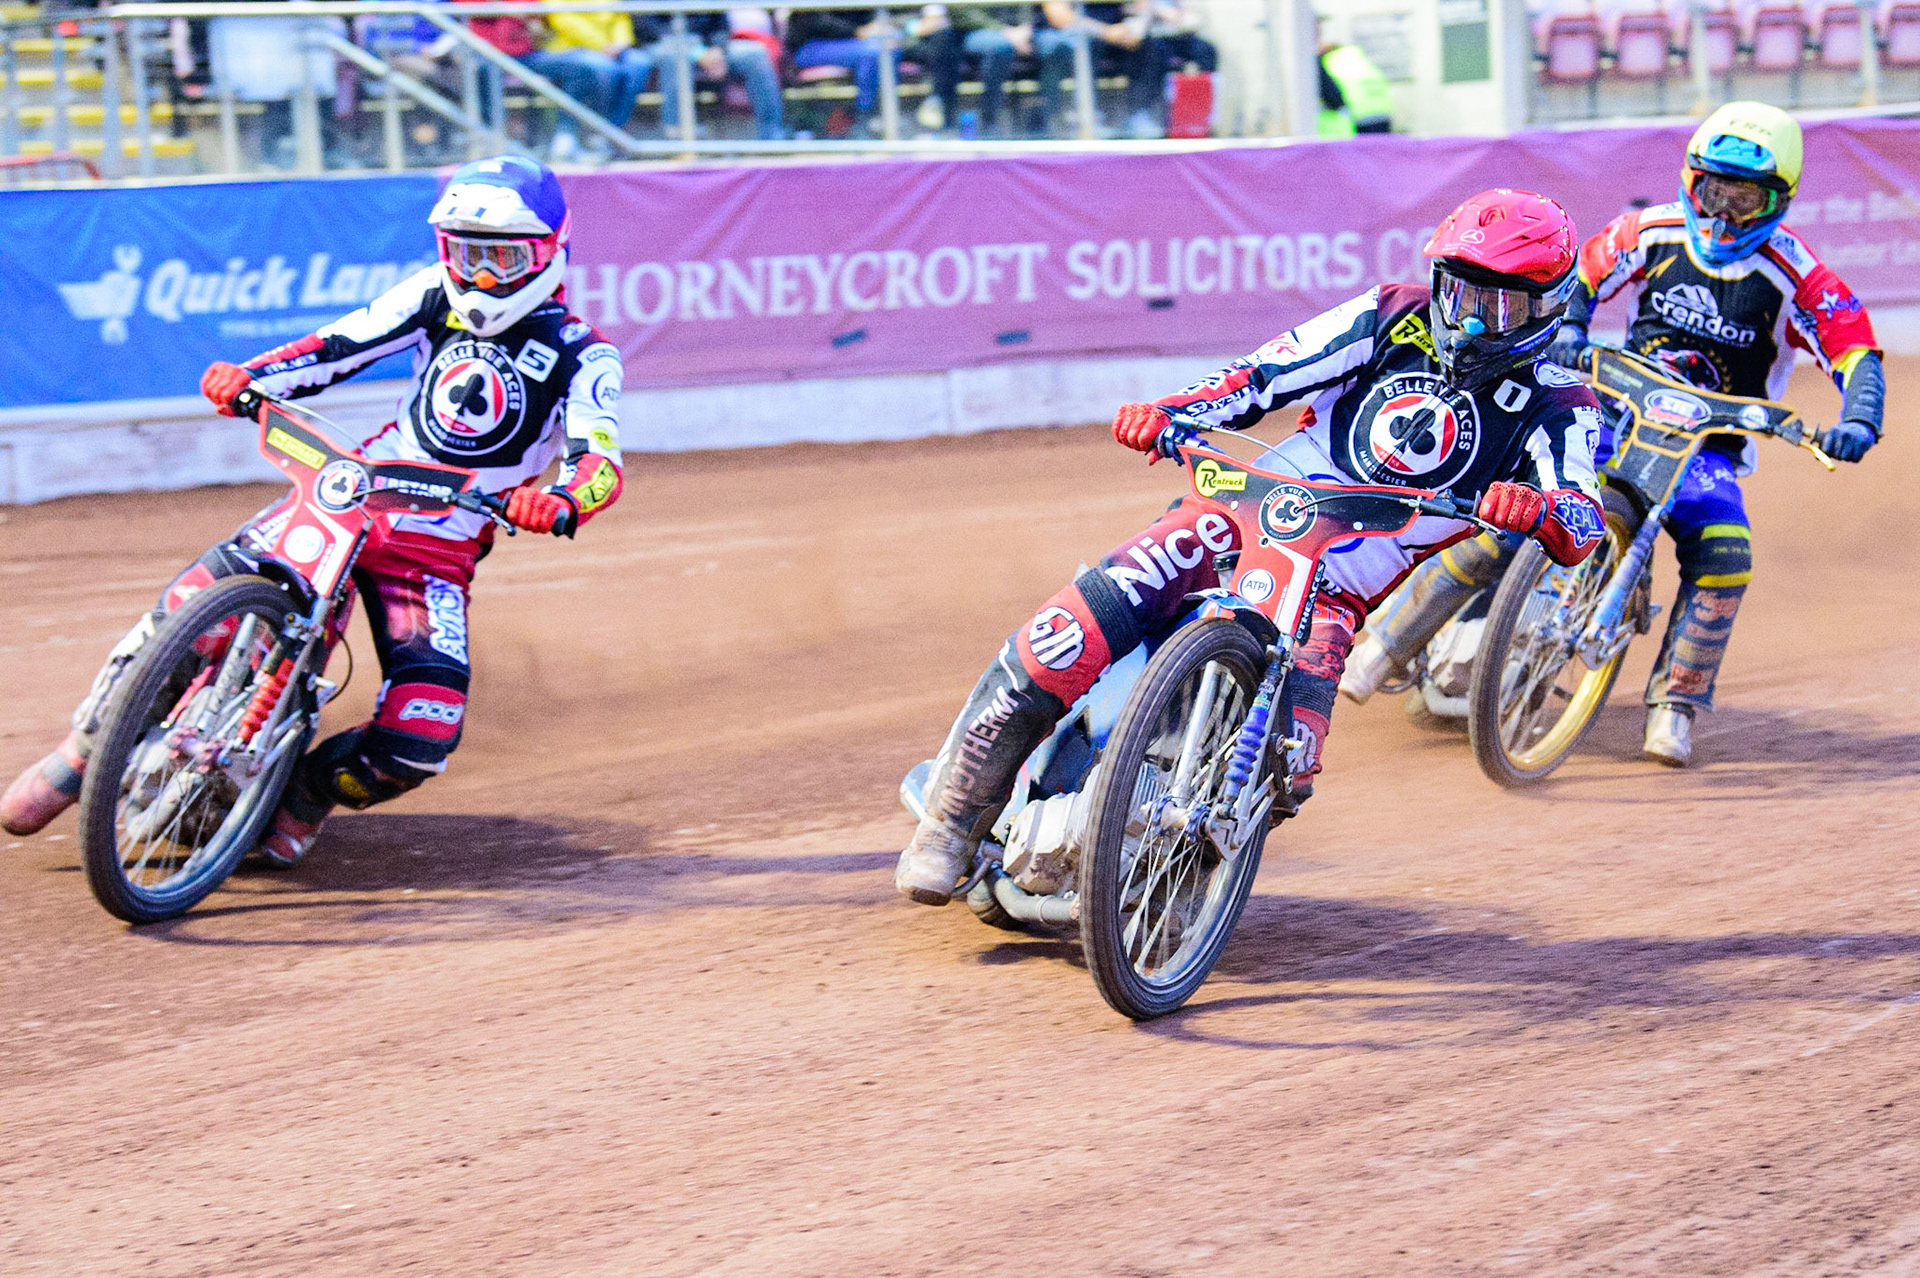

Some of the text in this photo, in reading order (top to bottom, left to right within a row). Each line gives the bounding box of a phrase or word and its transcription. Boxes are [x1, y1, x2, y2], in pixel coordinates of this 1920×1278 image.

[146, 252, 436, 322] Quick Lan
[1651, 291, 1756, 343] Crendon
[436, 345, 521, 411] BELLE VUE ACES
[1503, 386, 1521, 408] 1
[1384, 379, 1434, 398] BELLE
[1457, 409, 1473, 450] ACES
[1200, 468, 1244, 489] Rentruck
[1359, 450, 1407, 486] MANCESTER
[1265, 487, 1286, 505] BELLE
[1288, 487, 1304, 497] VUE
[1105, 513, 1233, 607] Nice
[1244, 579, 1268, 591] ATPI
